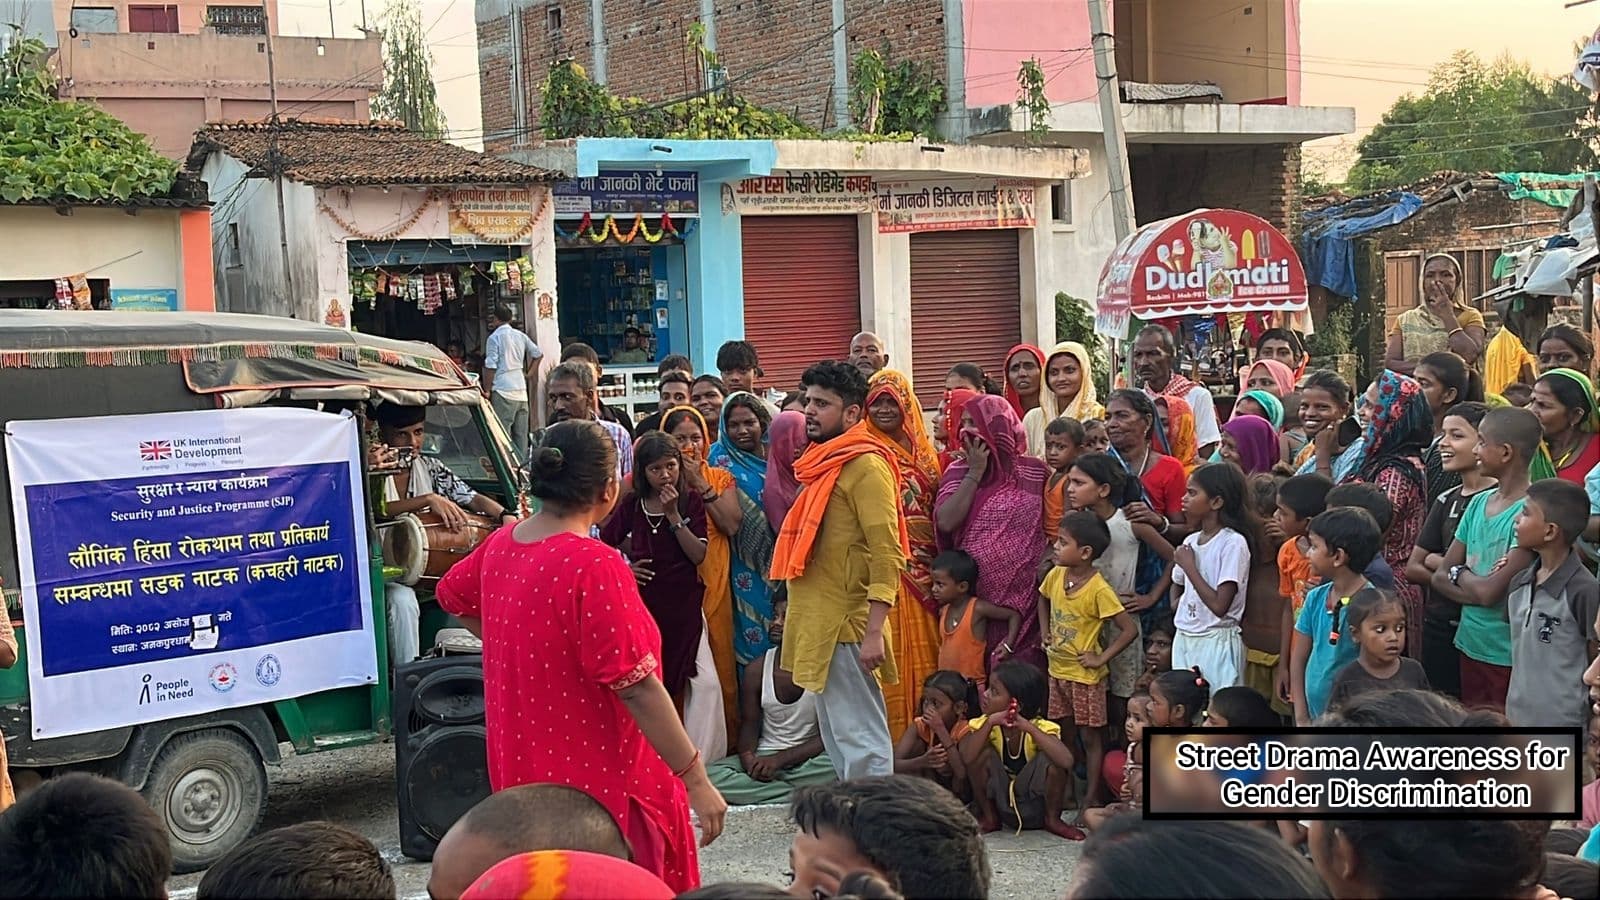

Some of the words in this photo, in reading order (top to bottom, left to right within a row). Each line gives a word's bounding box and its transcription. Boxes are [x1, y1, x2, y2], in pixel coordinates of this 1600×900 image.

[600, 173, 641, 192] जानकी
[736, 178, 763, 194] आर
[765, 177, 784, 194] एस
[894, 188, 930, 209] जानकी
[933, 187, 974, 209] डिजिटल
[189, 436, 241, 447] International
[175, 446, 242, 458] Development
[136, 483, 173, 504] सुरक्षा
[176, 482, 184, 496] र
[186, 479, 218, 493] न्याय
[219, 473, 269, 491] कार्यक्रम
[111, 509, 154, 521] Security
[157, 505, 176, 517] and
[178, 503, 213, 516] Justice
[215, 499, 270, 513] Programme
[271, 496, 294, 509] (SJP)
[133, 538, 172, 564] हिंसा
[178, 535, 243, 558] रोकथाम
[248, 532, 276, 549] तथा
[281, 520, 330, 546] प्रतिकार्य
[53, 579, 133, 605] सम्बन्धमा
[139, 573, 185, 595] सडक
[192, 567, 239, 588] नाटक
[246, 555, 299, 584] (कचहरी
[304, 553, 345, 574] नाटक)
[217, 611, 232, 622] गते
[156, 679, 189, 691] People
[157, 693, 166, 702] in
[168, 688, 194, 700] Need
